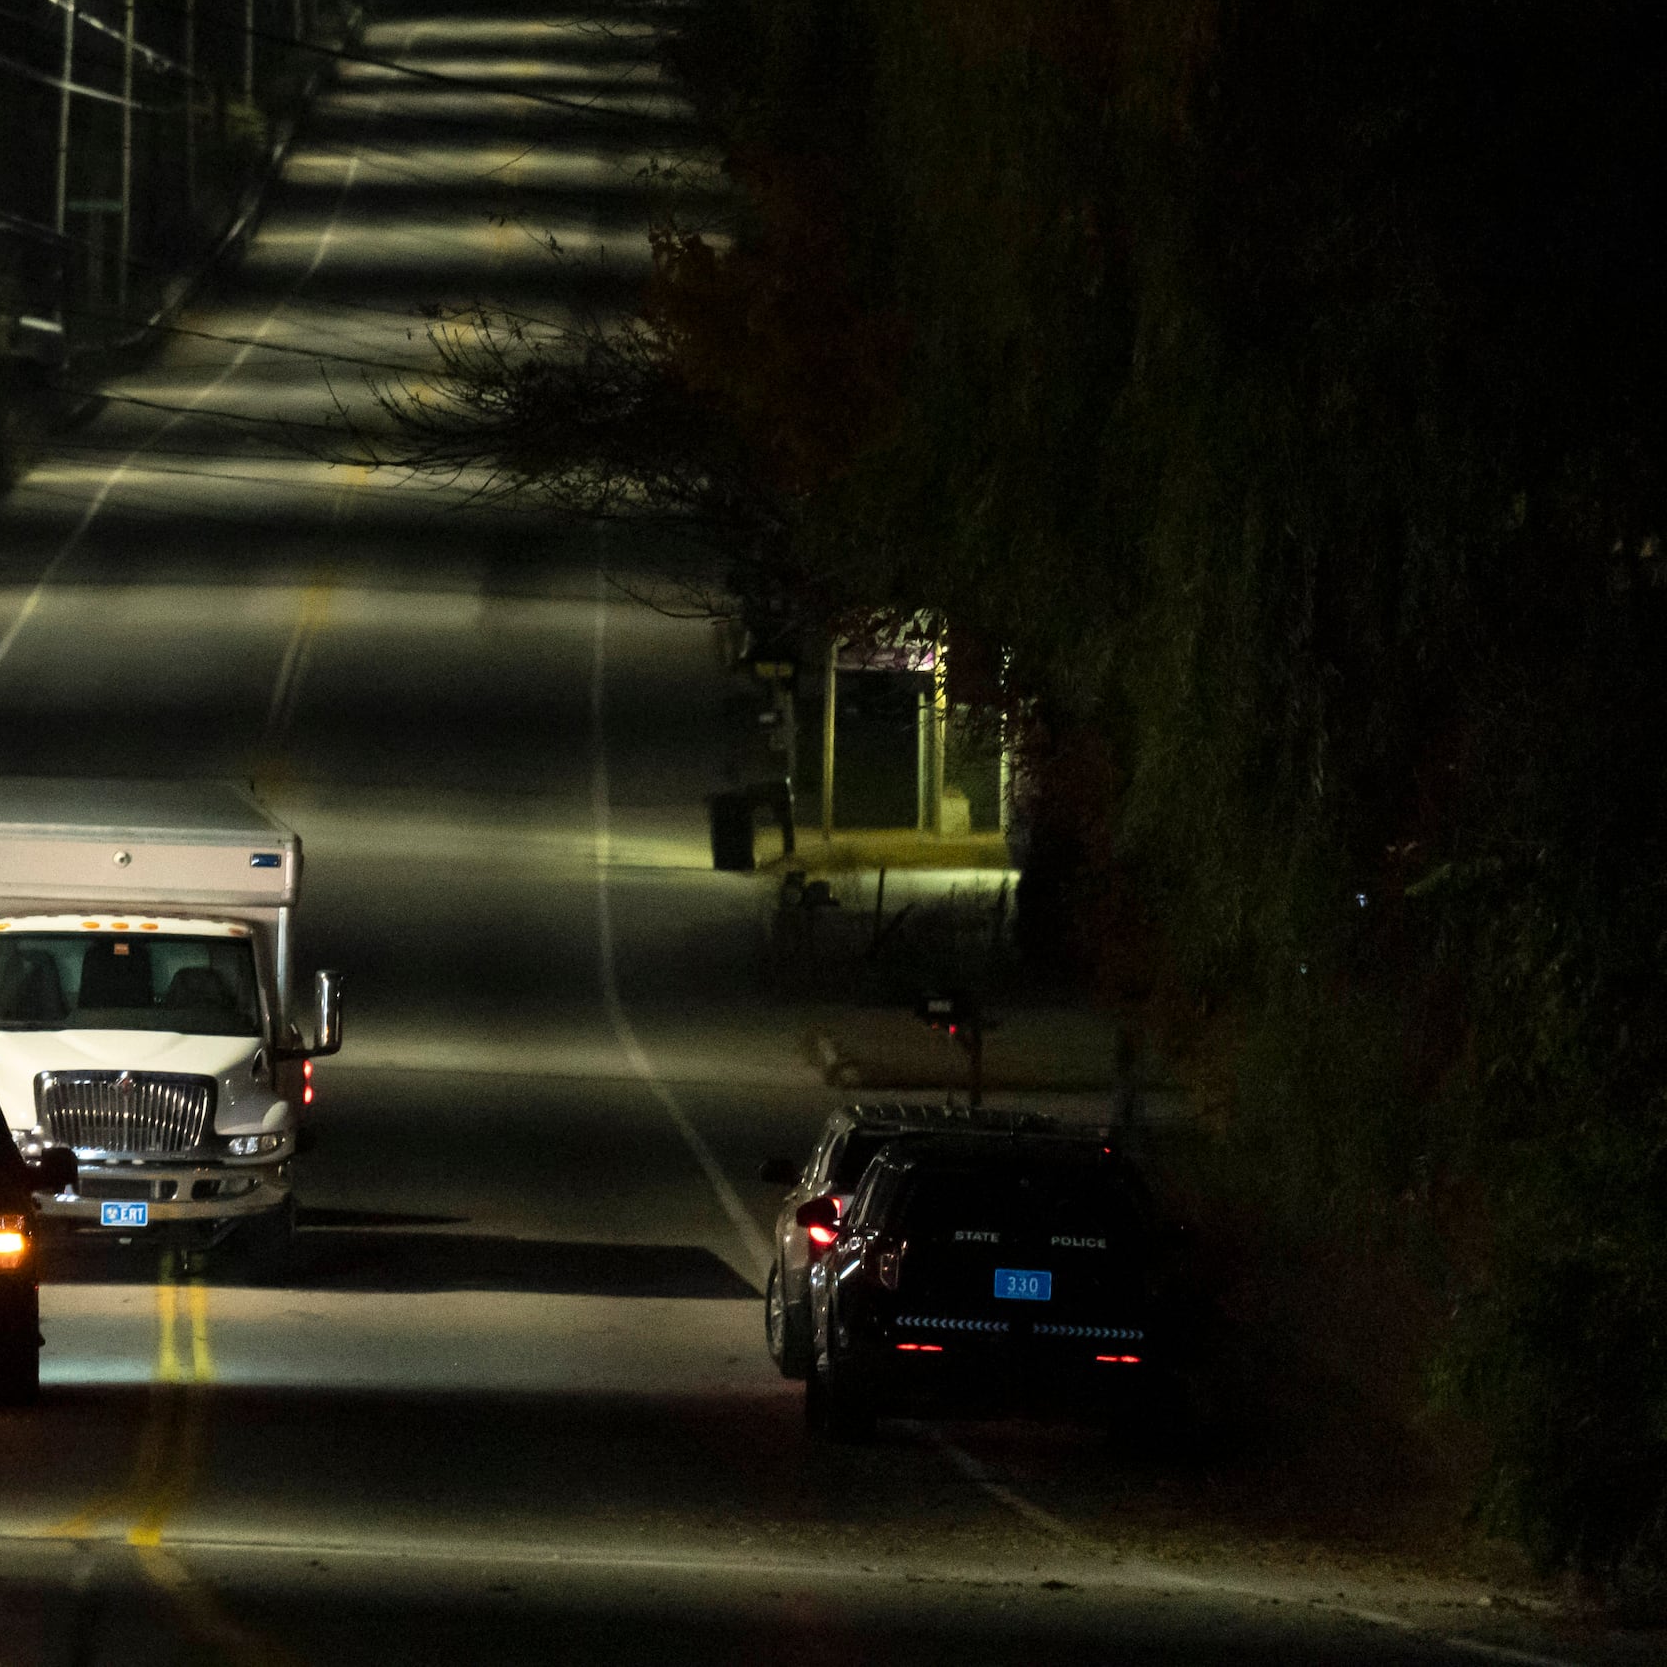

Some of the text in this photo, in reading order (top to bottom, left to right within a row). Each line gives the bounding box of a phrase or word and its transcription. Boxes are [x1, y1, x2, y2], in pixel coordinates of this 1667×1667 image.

[954, 1230, 1108, 1250] STATE POLICE
[1007, 1276, 1039, 1293] 330
